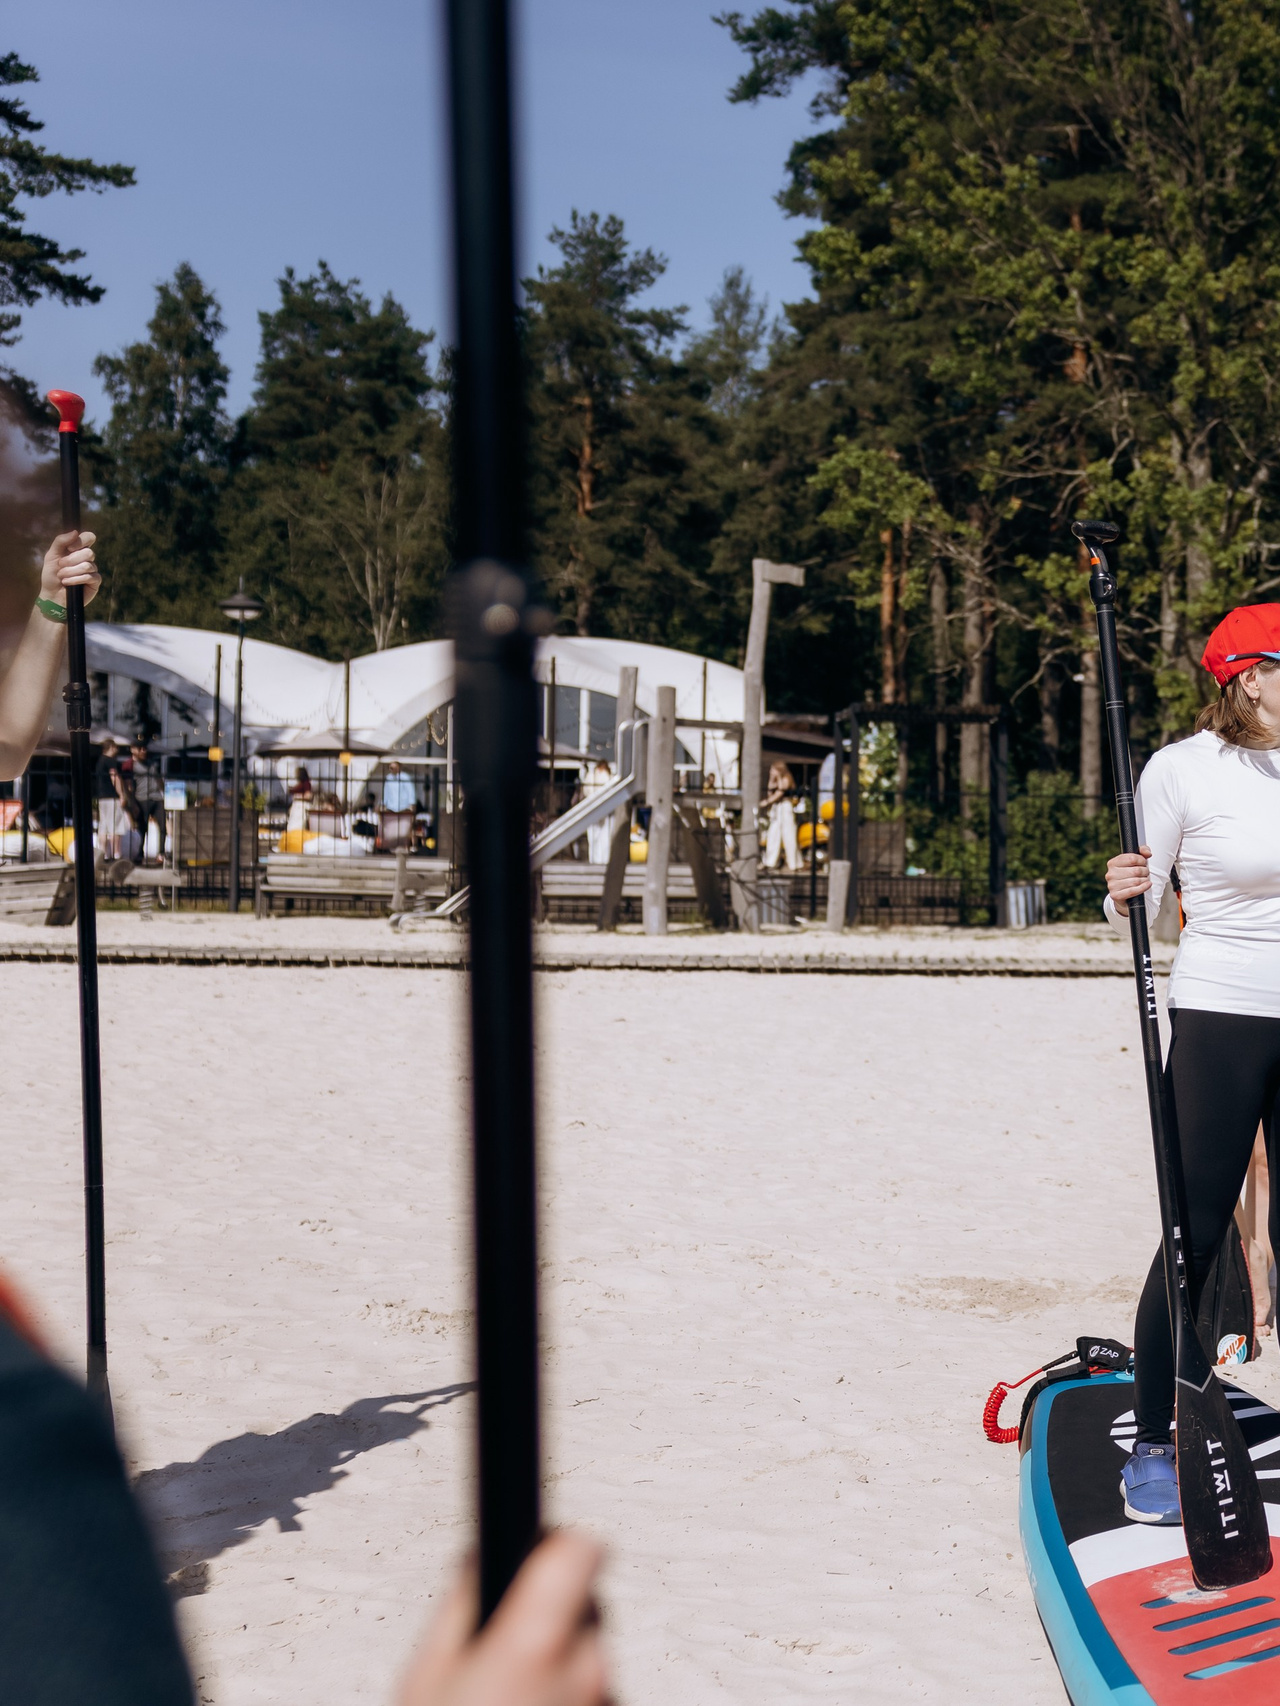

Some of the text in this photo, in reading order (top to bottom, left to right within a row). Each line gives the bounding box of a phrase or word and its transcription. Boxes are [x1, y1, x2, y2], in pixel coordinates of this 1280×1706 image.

[1142, 954, 1158, 1019] ITIWIT
[1099, 1347, 1119, 1358] ZAP
[1223, 1339, 1240, 1359] SUP
[1206, 1439, 1239, 1539] ITIWIT
